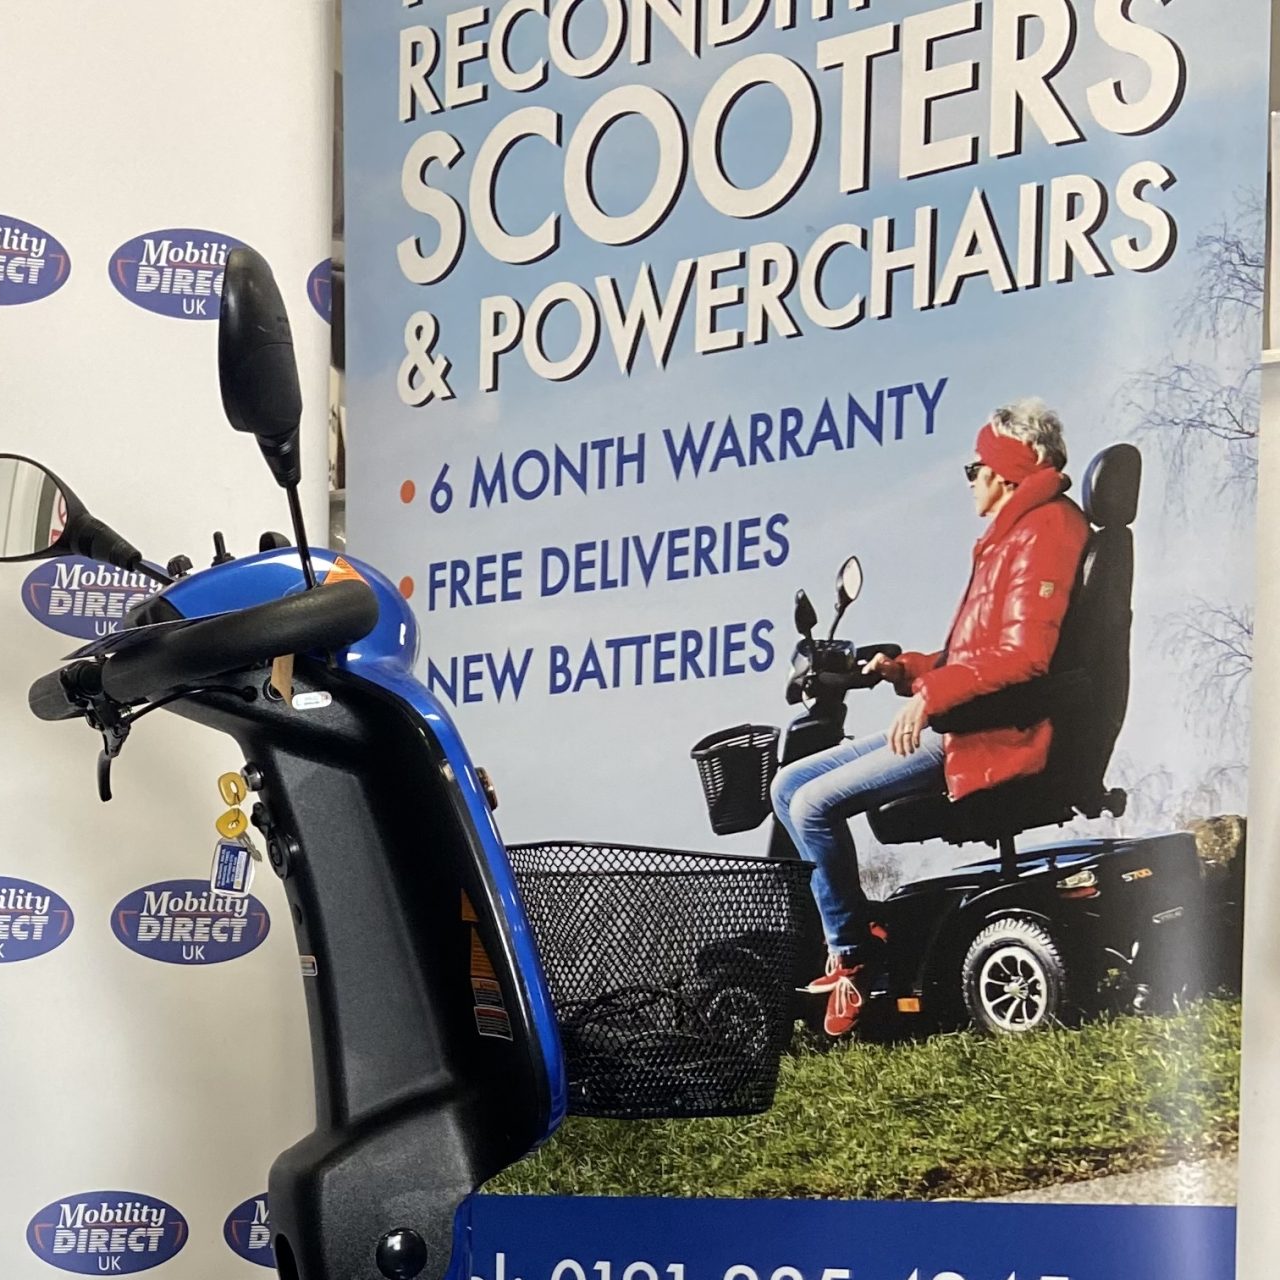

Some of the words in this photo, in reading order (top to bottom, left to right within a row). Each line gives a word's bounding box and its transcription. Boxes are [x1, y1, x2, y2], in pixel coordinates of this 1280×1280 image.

[396, 0, 1186, 285] SCOOTERS
[139, 239, 229, 267] Mobili
[135, 266, 224, 298] DIRE
[396, 311, 456, 408] &
[479, 161, 1177, 392] POWERCHAIRS
[182, 298, 206, 315] UK
[429, 463, 454, 514] 6
[469, 432, 646, 508] MONTH
[662, 377, 949, 481] WARRANTY
[428, 551, 522, 612] FREE
[540, 513, 790, 598] DELIVERIES
[95, 620, 118, 636] UK
[428, 648, 533, 708] NEW
[548, 619, 775, 695] BATTERIES
[140, 891, 249, 917] Mobility
[137, 916, 248, 942] DIRECT
[182, 945, 205, 960] UK
[55, 1203, 165, 1229] Mobility
[52, 1227, 164, 1254] DIRECT
[98, 1255, 121, 1271] UK
